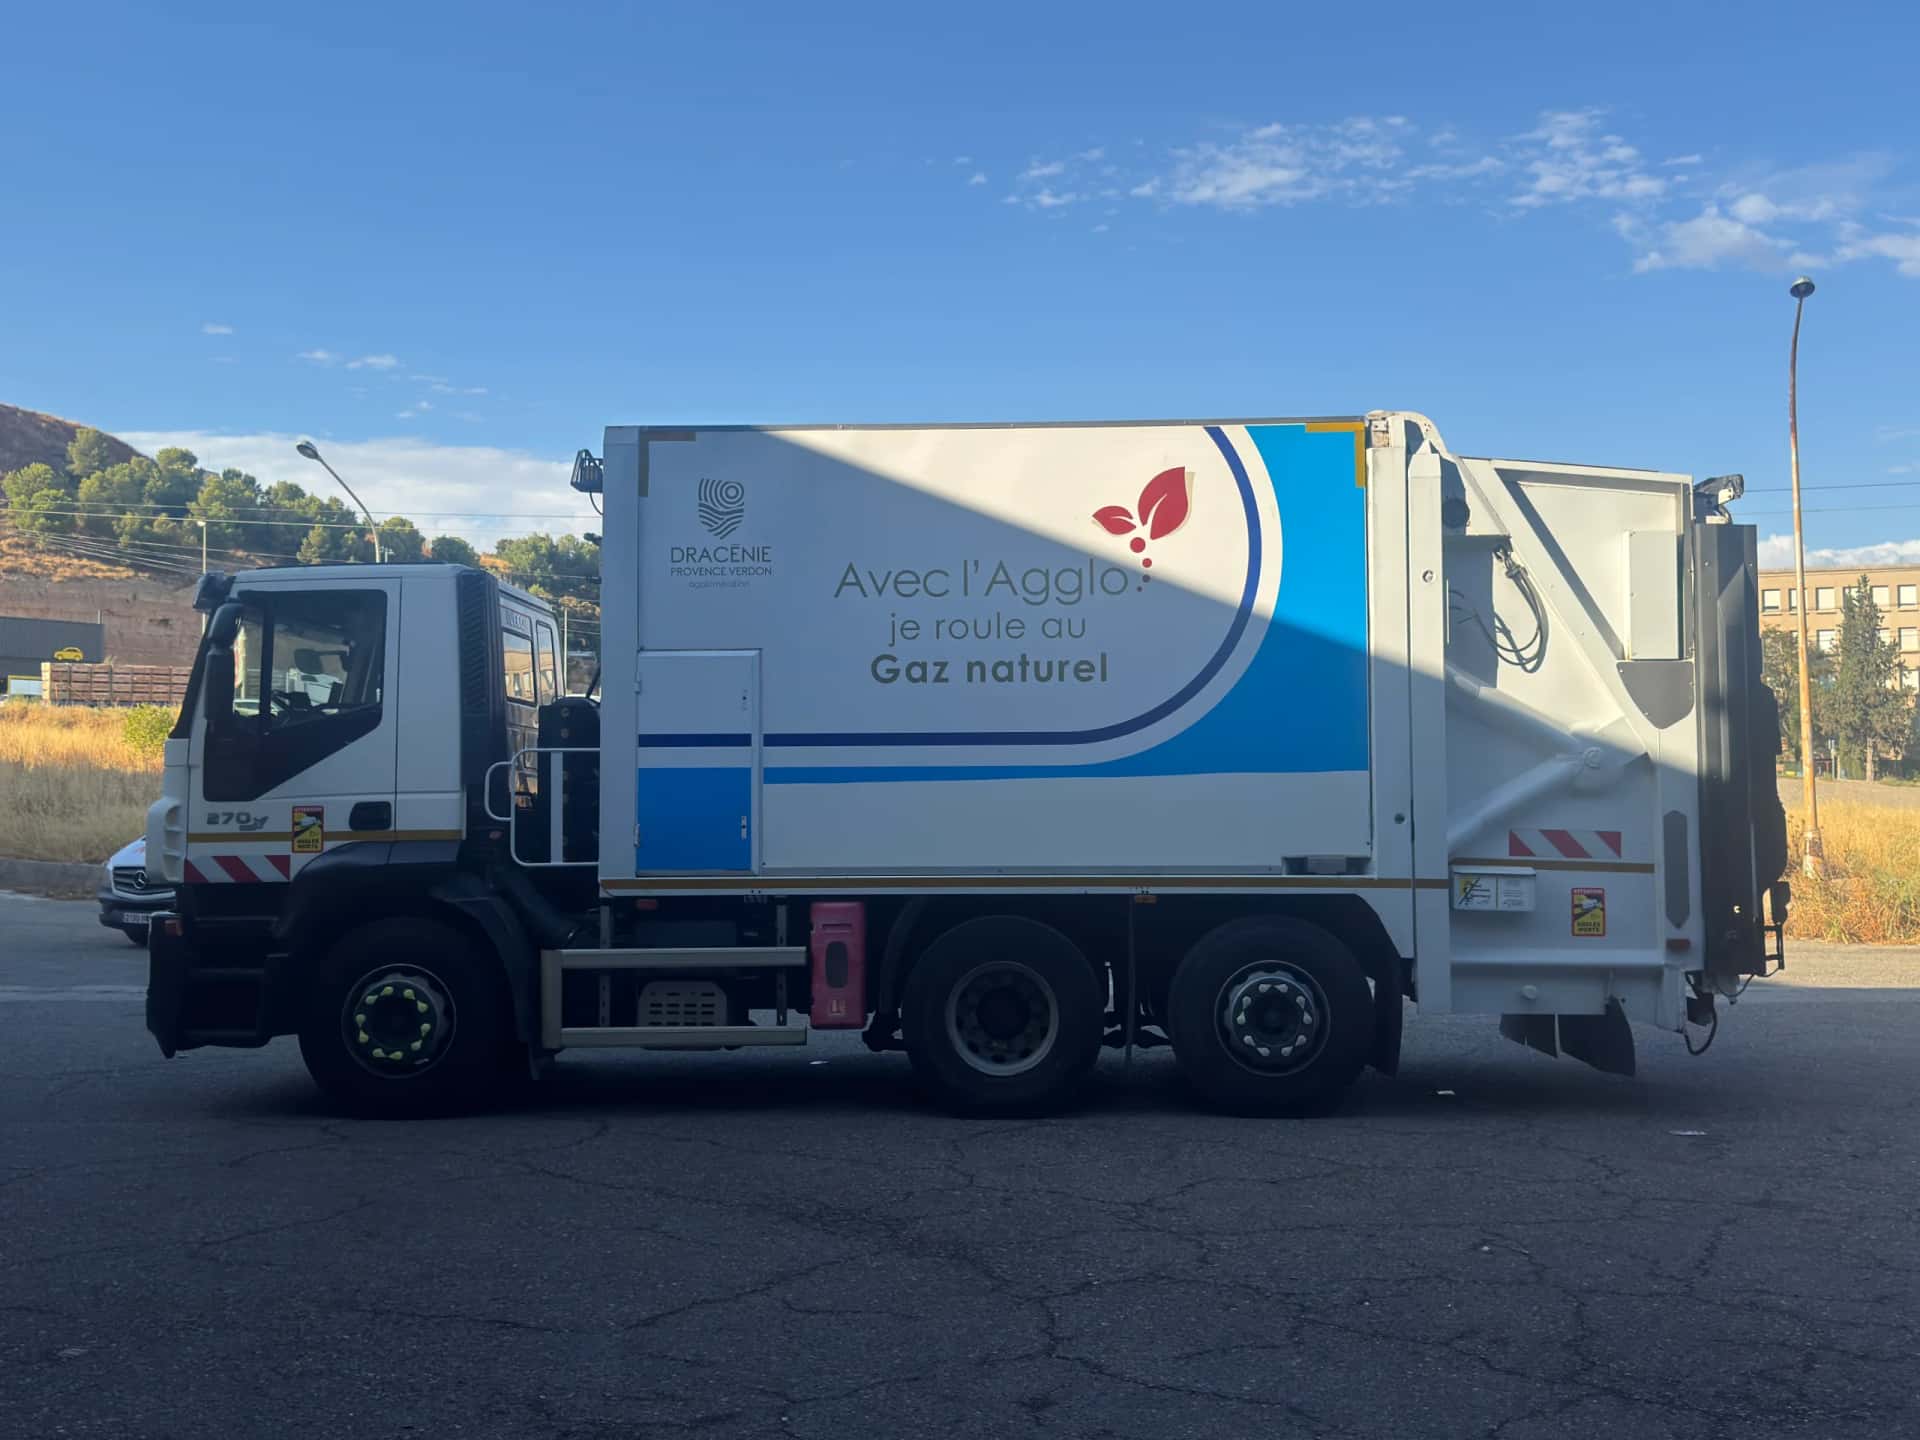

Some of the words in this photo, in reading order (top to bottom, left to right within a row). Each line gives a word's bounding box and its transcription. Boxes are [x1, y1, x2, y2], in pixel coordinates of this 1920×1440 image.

[670, 566, 727, 577] PROVENCE
[728, 566, 773, 577] VERDON
[834, 561, 950, 599] Avec
[962, 558, 1130, 607] l'Agglo
[887, 612, 921, 648] je
[935, 612, 1026, 641] roule
[1041, 617, 1087, 640] au
[870, 653, 950, 685] Gaz
[966, 652, 1108, 684] naturel
[206, 812, 251, 825] 270
